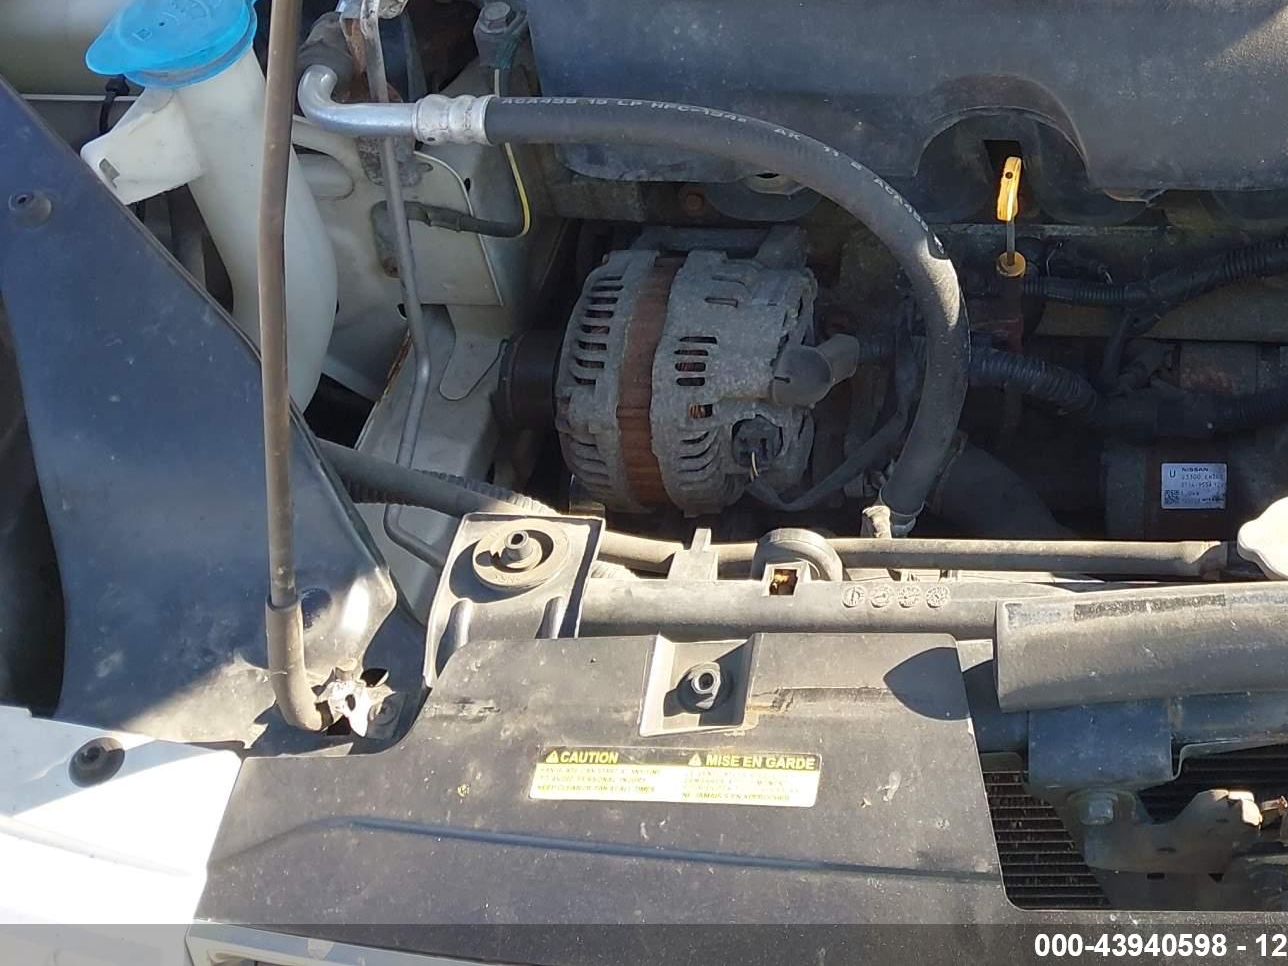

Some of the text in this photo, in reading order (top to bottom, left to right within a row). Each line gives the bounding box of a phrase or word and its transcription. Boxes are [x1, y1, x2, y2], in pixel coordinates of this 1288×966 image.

[560, 751, 619, 764] CAUTION
[706, 754, 816, 770] MISE EN GARDE
